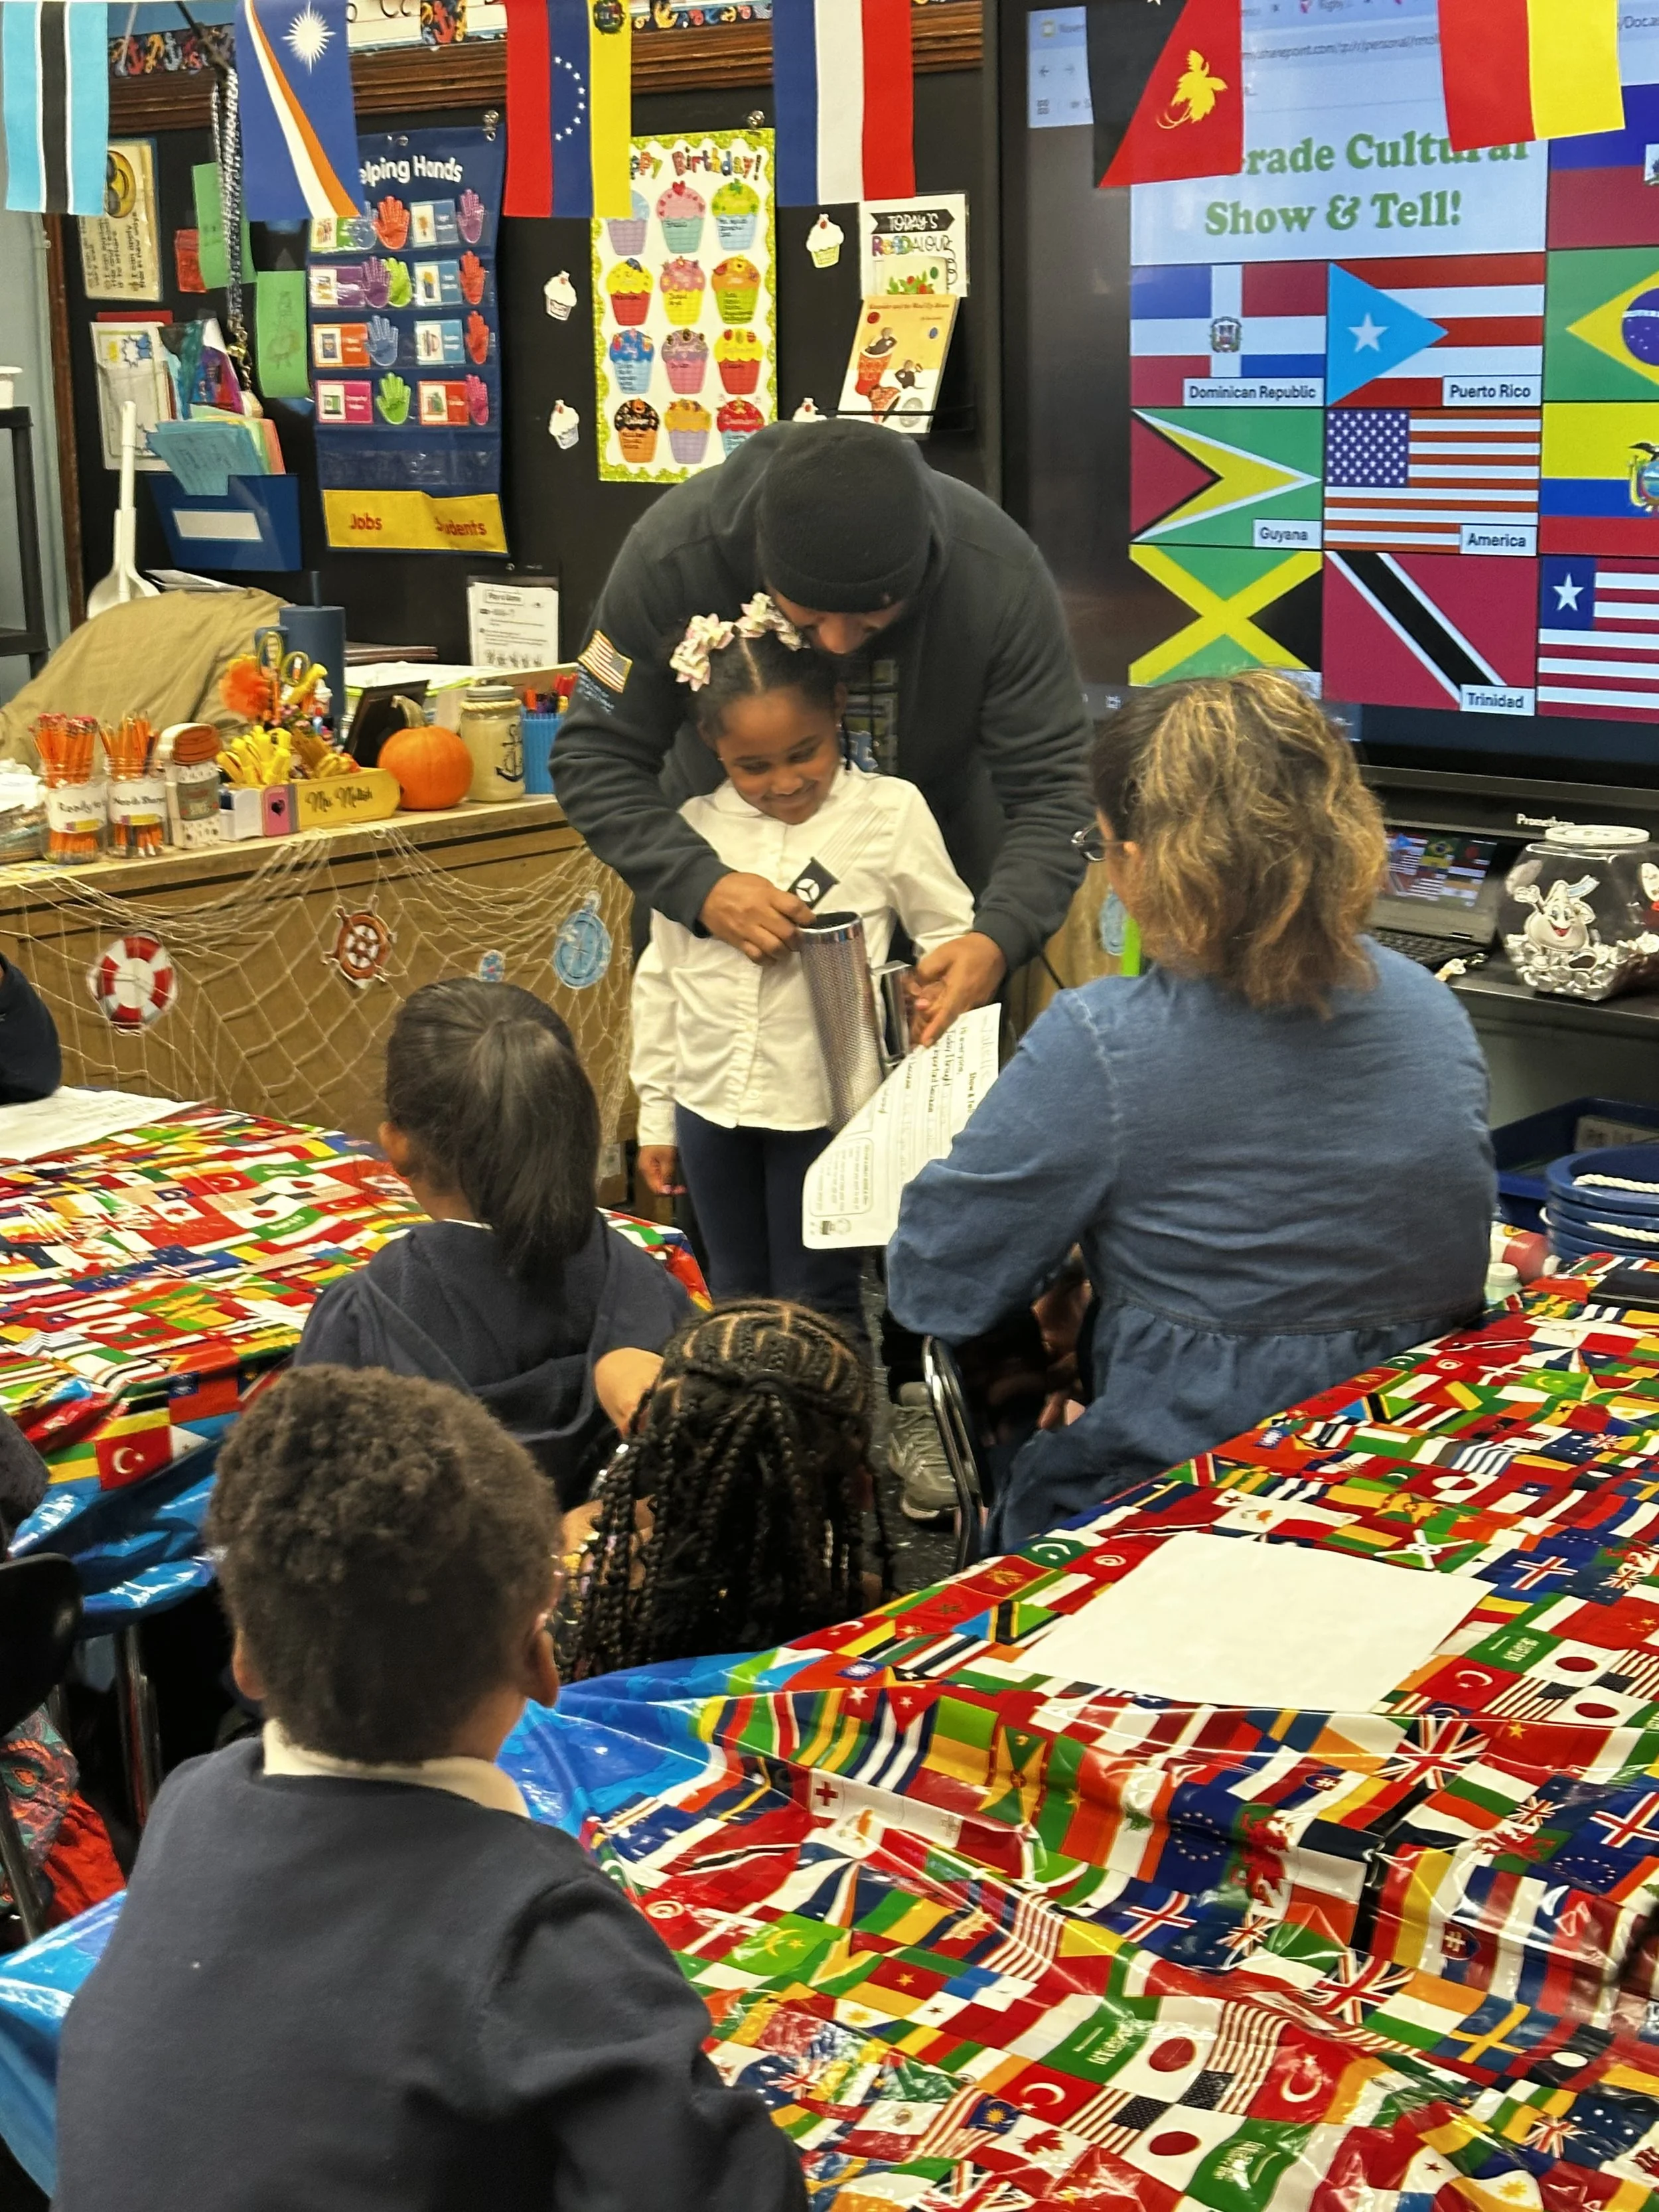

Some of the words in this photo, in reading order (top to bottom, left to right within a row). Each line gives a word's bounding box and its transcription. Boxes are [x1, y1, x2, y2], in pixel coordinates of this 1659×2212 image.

[1243, 137, 1335, 176] rade
[359, 157, 411, 187] elping
[413, 155, 463, 183] Hands
[887, 212, 939, 232] TODAY'S
[1205, 201, 1317, 235] Show
[1326, 194, 1362, 230] &
[1371, 190, 1462, 228] Tell!
[1189, 386, 1256, 400] Dominican
[1260, 385, 1316, 402] Republic
[1450, 384, 1496, 398] Puerto
[1500, 384, 1531, 398] Rico
[349, 512, 383, 531] Jobs
[1261, 526, 1308, 543] Guyana
[1467, 534, 1526, 548] America
[1467, 692, 1524, 709] Trinidad
[968, 1072, 977, 1091] Show
